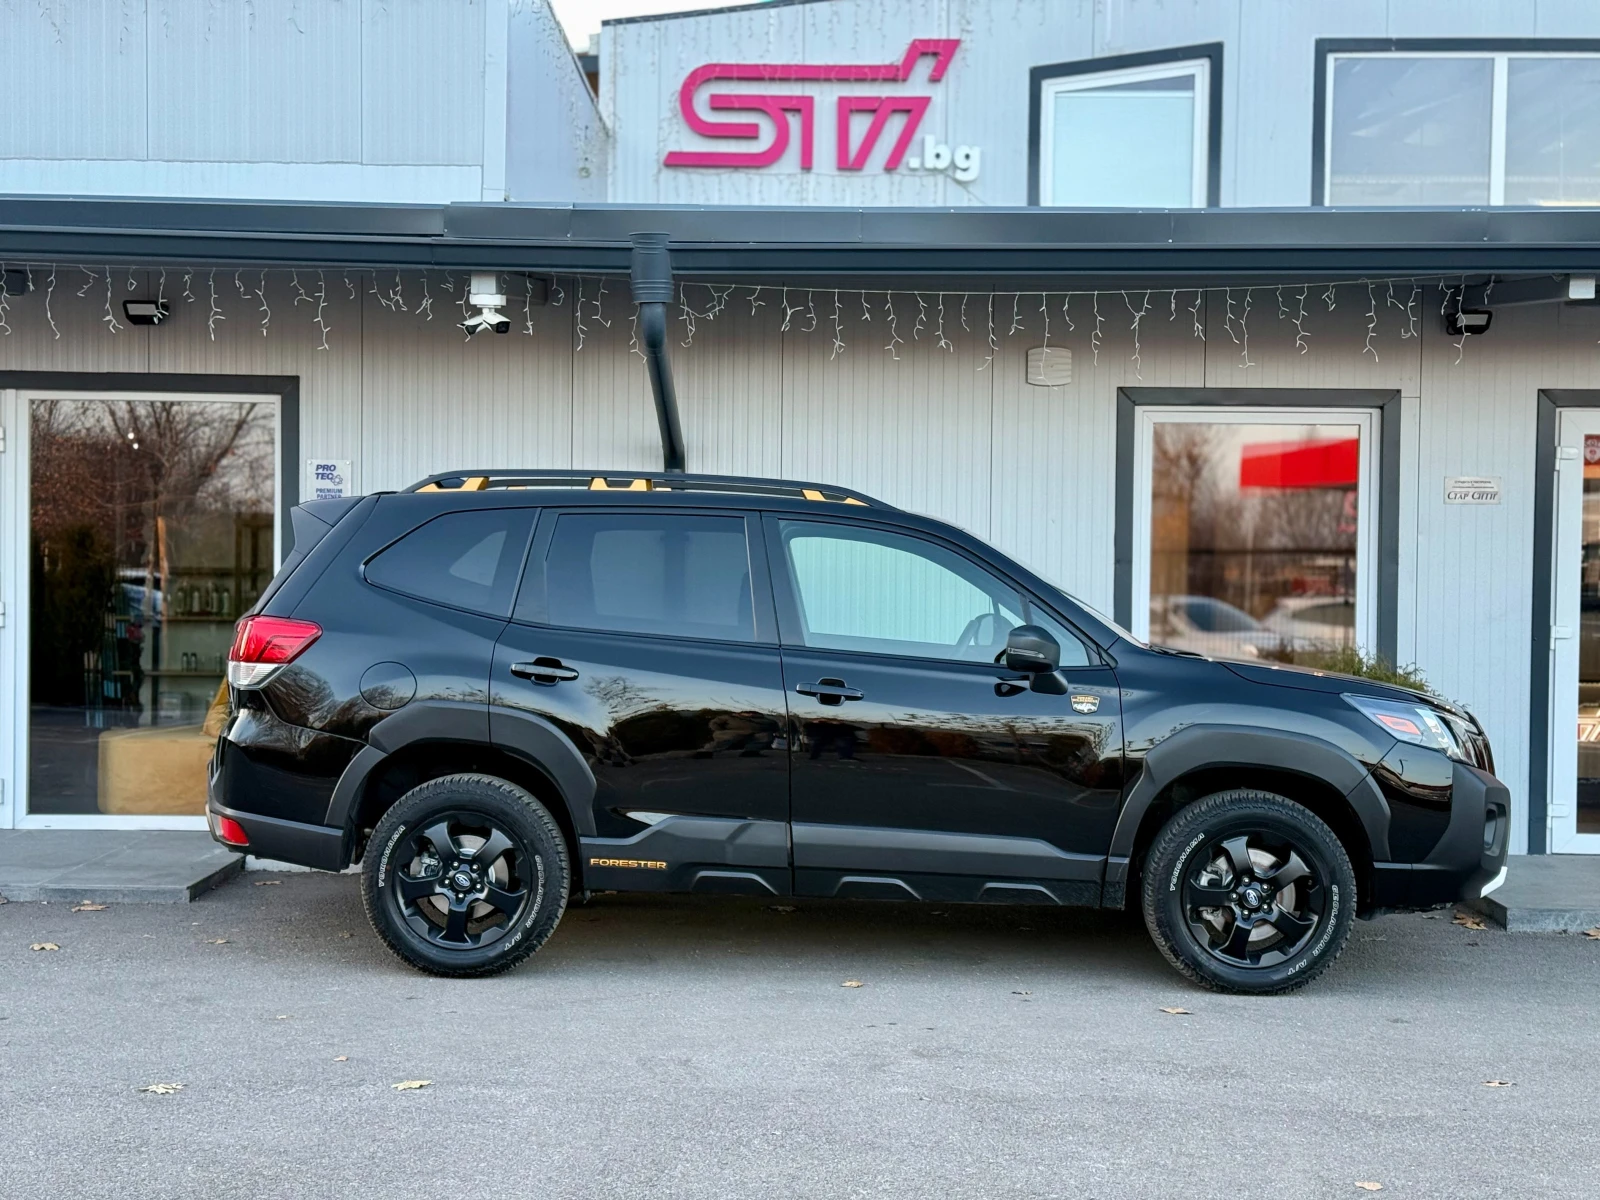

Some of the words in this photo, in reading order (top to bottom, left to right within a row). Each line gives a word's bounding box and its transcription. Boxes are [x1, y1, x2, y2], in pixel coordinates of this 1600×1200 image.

[315, 464, 336, 472] PRO
[315, 472, 334, 480] TEC
[378, 824, 406, 888] YOKOHAMA
[589, 858, 668, 869] FORESTER
[1169, 832, 1205, 892] YOKOHAMA
[525, 854, 546, 929] GEOLANDAR
[1311, 884, 1340, 957] GEOLANDAR
